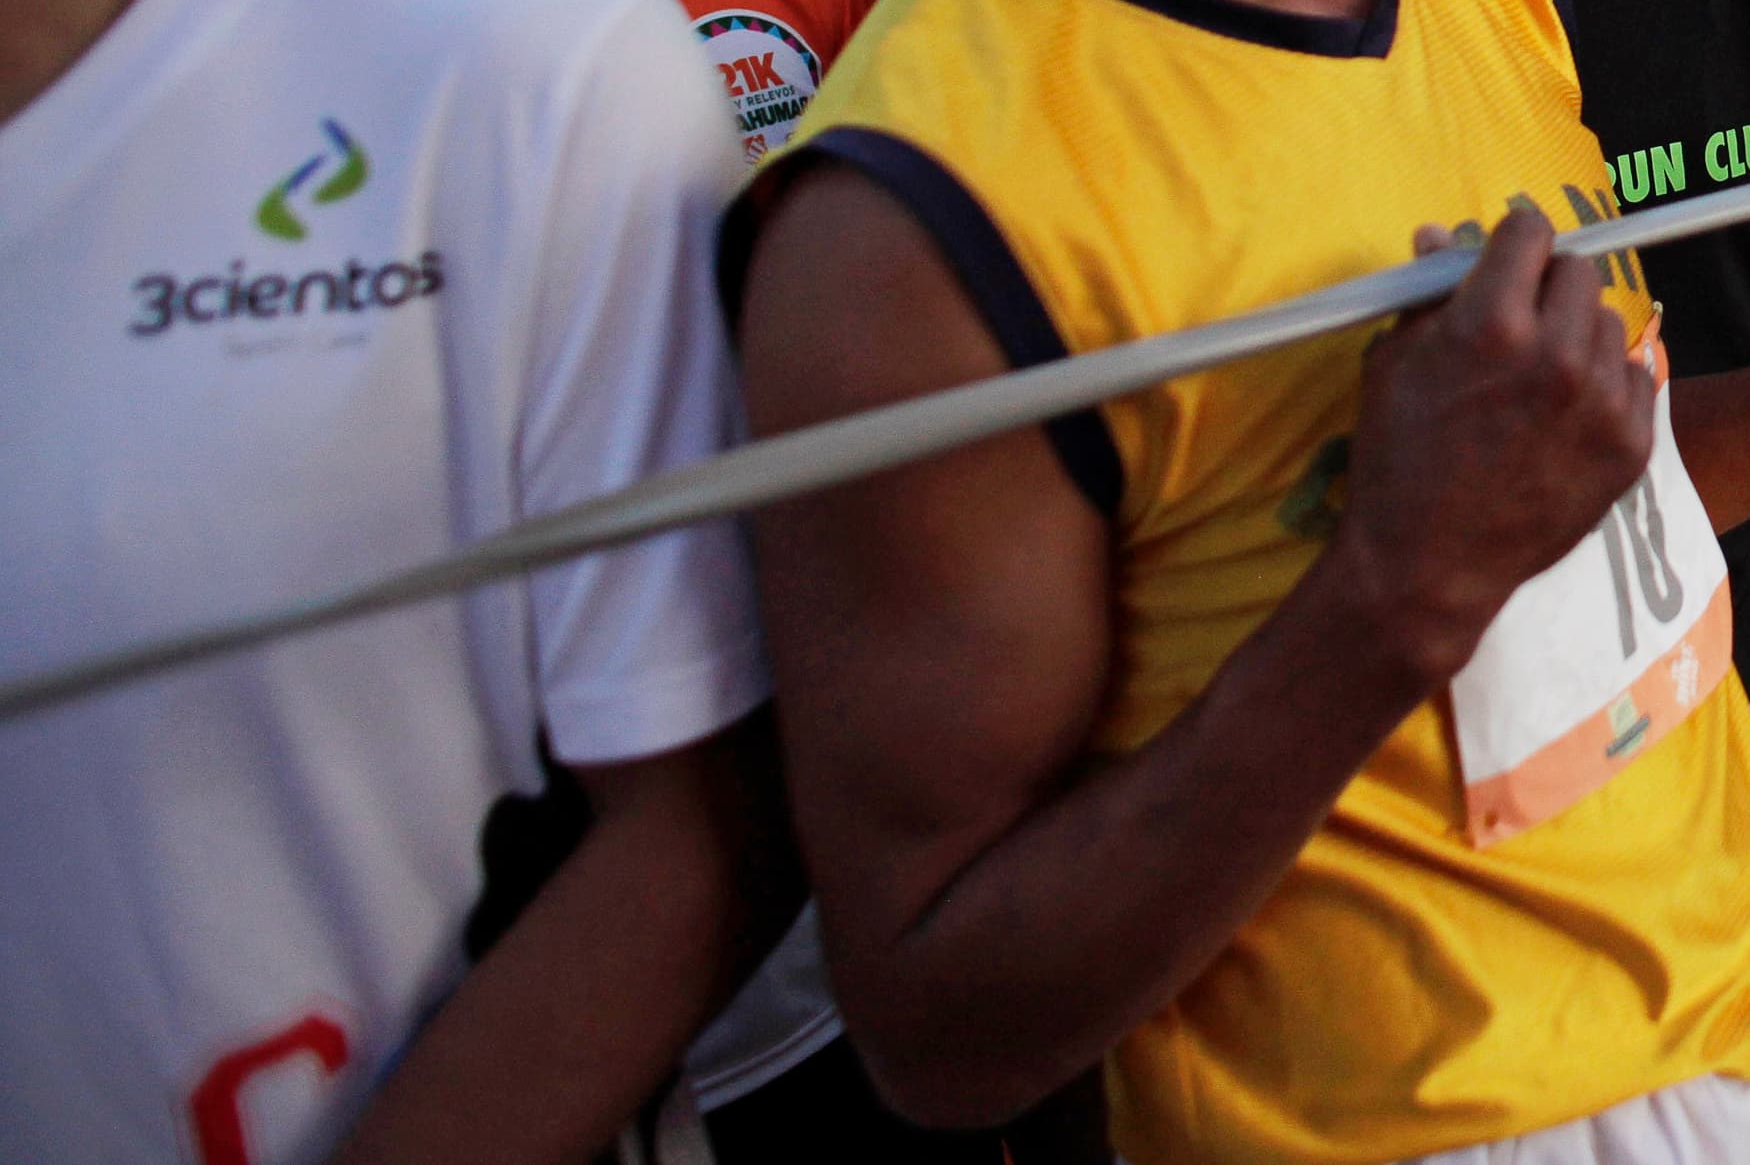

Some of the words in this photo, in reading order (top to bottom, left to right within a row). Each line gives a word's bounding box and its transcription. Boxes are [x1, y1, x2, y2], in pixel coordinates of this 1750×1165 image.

[717, 51, 784, 97] 21K
[746, 85, 795, 106] RELEVOS
[127, 249, 446, 337] 3cientos
